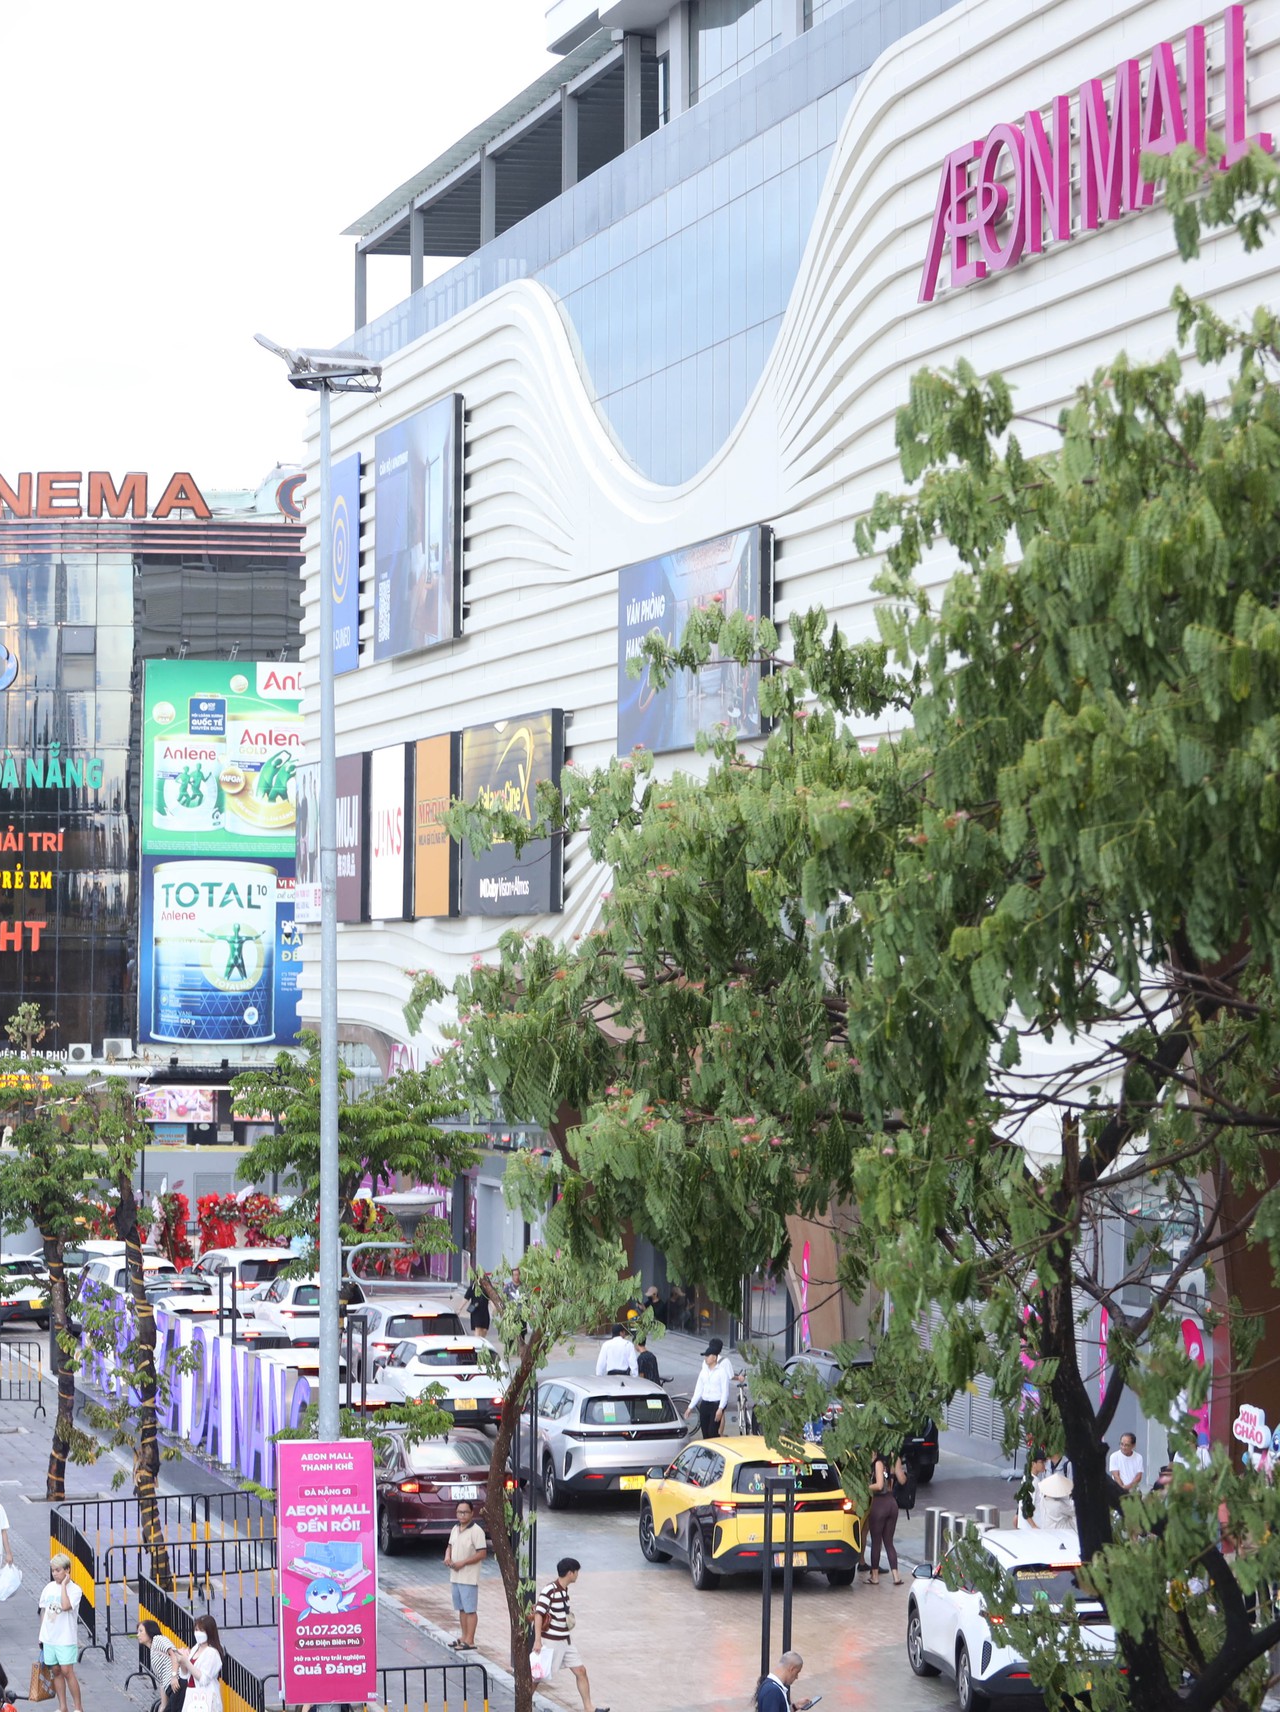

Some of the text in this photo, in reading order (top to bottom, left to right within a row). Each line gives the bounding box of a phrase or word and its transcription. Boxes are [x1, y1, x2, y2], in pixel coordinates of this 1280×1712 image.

[641, 591, 666, 623] PHÒNG
[191, 718, 213, 726] QUỐC
[163, 747, 216, 760] Anlene
[26, 742, 104, 790] NẴNG
[335, 795, 359, 849] MUJI
[374, 806, 403, 858] JINS
[28, 827, 66, 852] TRÍ
[29, 871, 53, 889] EM
[161, 882, 268, 910] TOTAL 10
[161, 910, 196, 921] Anlene
[20, 1048, 43, 1060] BÊN
[46, 1048, 68, 1061] PHỦ
[1240, 1410, 1257, 1427] XIN
[1233, 1422, 1263, 1444] CHÀO
[301, 1452, 354, 1461] AEON MALL
[301, 1461, 354, 1471] THANH KHÊ
[304, 1488, 317, 1496] ĐÀ
[285, 1503, 371, 1517] AEON MALL
[296, 1516, 361, 1533] ĐẾN RỒI!
[296, 1624, 362, 1636] 01.07.2026
[315, 1639, 331, 1647] Điện
[331, 1638, 347, 1646] Biên
[347, 1637, 360, 1645] Phủ
[293, 1662, 367, 1676] Quá Đáng!
